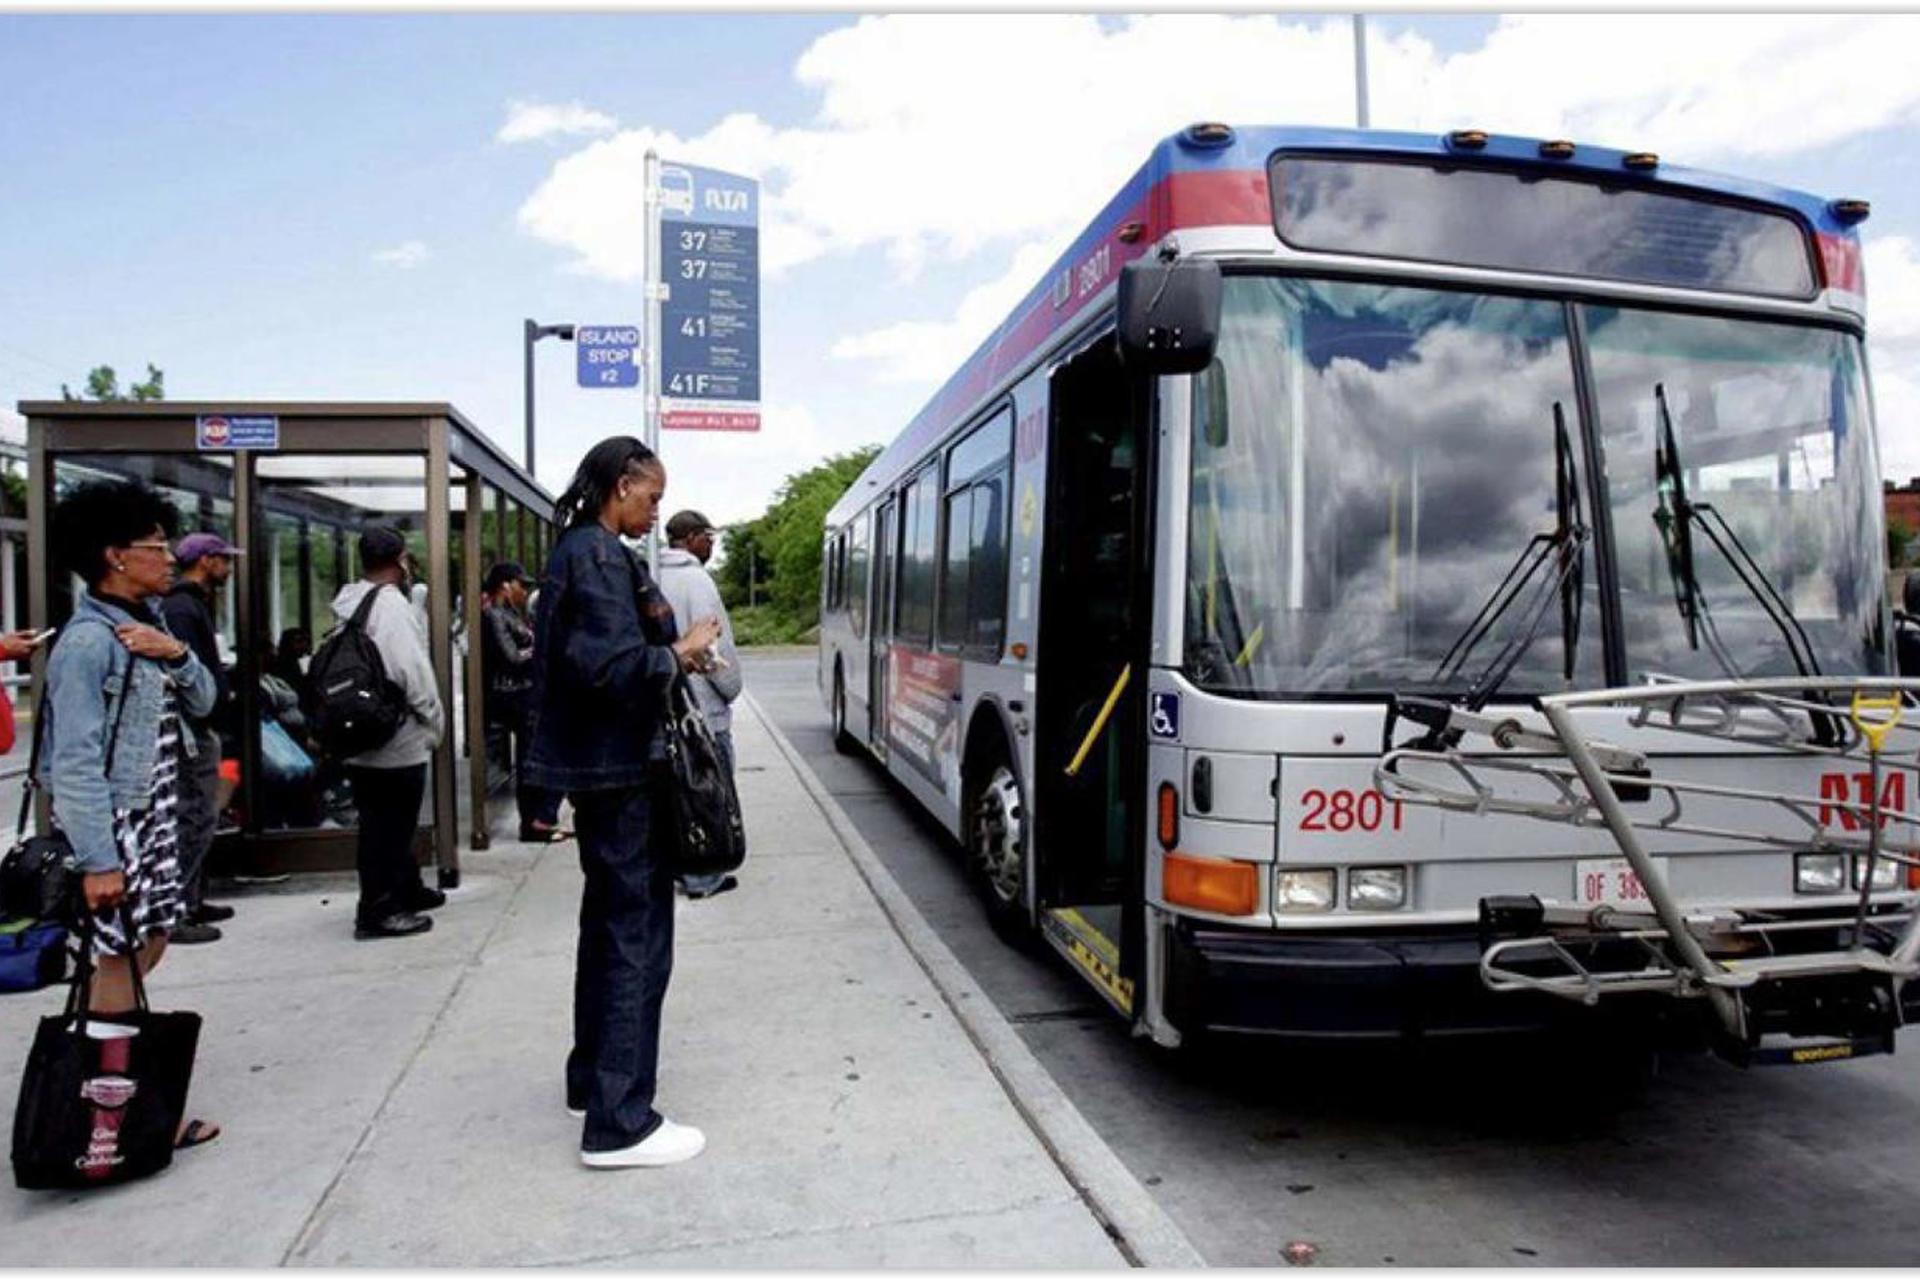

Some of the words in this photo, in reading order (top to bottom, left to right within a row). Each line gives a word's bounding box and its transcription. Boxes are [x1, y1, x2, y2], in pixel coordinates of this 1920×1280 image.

[680, 231, 706, 250] 37
[681, 259, 707, 279] 37
[1079, 243, 1110, 299] 2801
[681, 317, 706, 337] 41
[579, 330, 638, 345] ISLAND
[587, 348, 629, 364] STOP
[670, 374, 711, 394] 41F
[1299, 789, 1402, 832] 2801
[1820, 771, 1905, 832] RTA
[1586, 872, 1606, 901] OF
